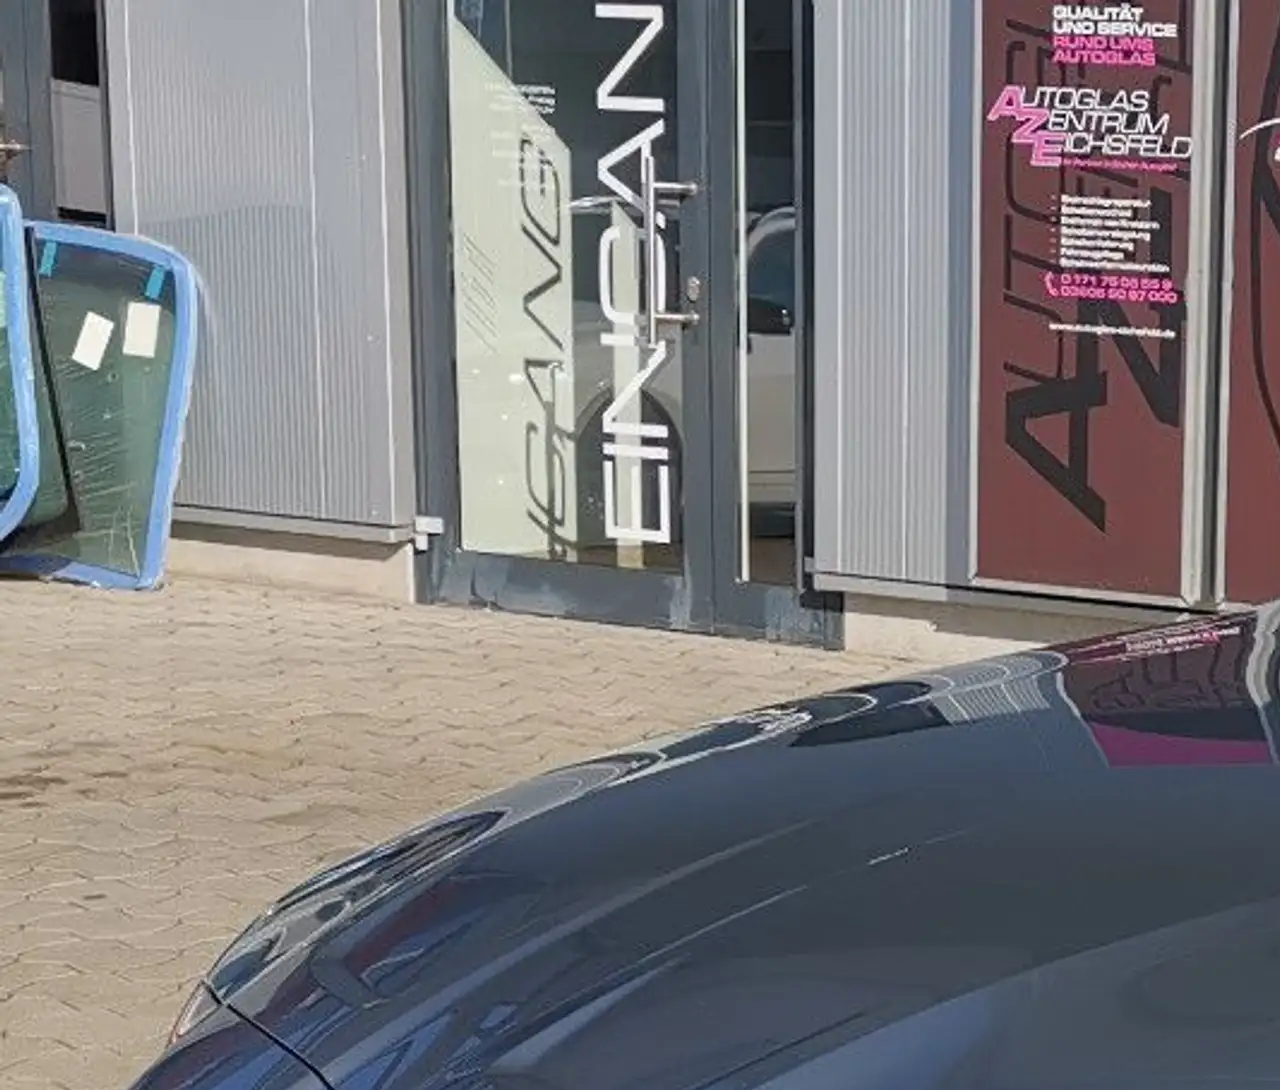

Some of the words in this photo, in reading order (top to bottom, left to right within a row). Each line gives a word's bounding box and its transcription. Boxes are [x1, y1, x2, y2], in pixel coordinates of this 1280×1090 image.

[1052, 3, 1144, 21] QUALITÄT
[1052, 22, 1095, 35] UND
[1097, 22, 1178, 37] SERVICE
[1053, 36, 1107, 49] RUND
[1110, 37, 1154, 50] UMS
[1053, 51, 1156, 66] AUTOGLAS
